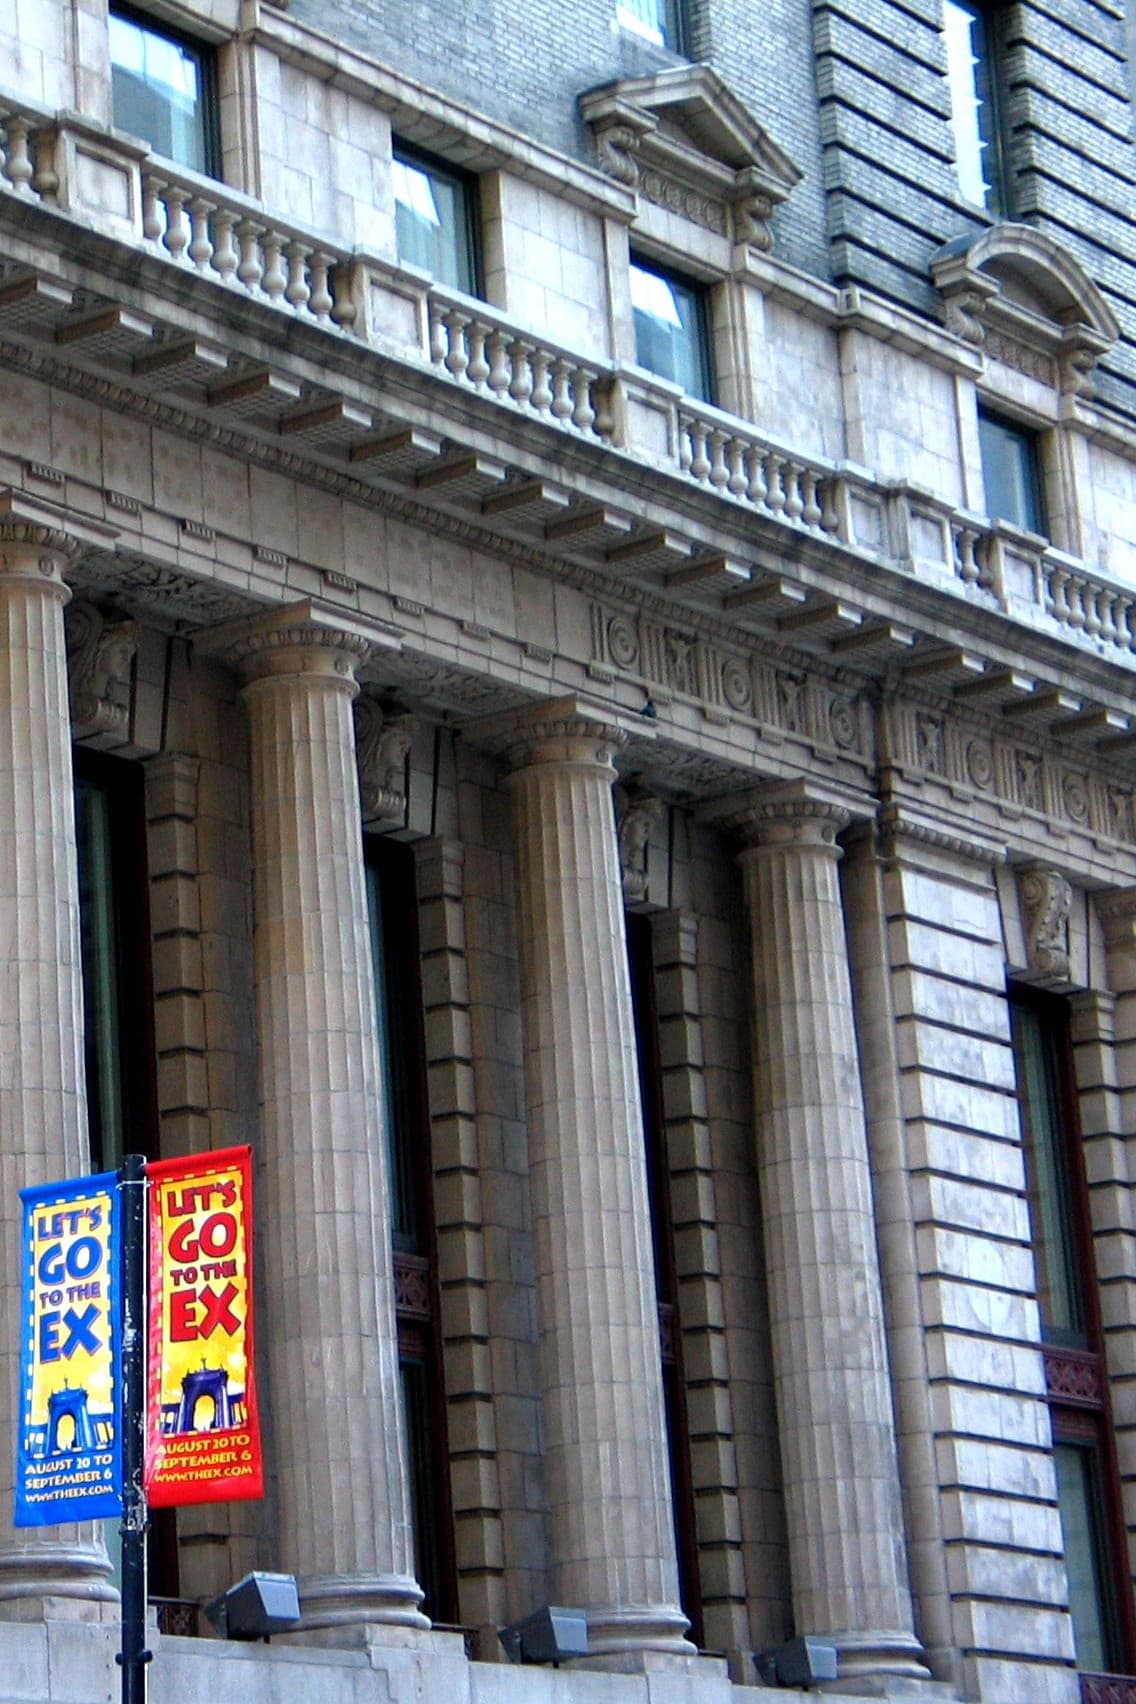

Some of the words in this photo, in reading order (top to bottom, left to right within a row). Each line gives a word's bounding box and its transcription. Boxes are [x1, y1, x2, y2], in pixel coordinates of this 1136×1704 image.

[167, 1180, 237, 1217] LET'S
[37, 1205, 102, 1241] LET'S
[168, 1211, 238, 1263] GO
[38, 1235, 103, 1286] GO
[170, 1266, 198, 1286] TO
[200, 1259, 237, 1281] THE
[39, 1289, 64, 1309] TO
[66, 1281, 101, 1303] THE
[170, 1281, 241, 1342] EX
[39, 1303, 103, 1364] EX
[154, 1451, 238, 1469] SEPTEMBER
[240, 1449, 252, 1461] 6
[155, 1440, 211, 1454] AUGUST
[212, 1438, 229, 1449] 20
[229, 1434, 251, 1446] TO
[25, 1458, 73, 1475] AUGUST
[76, 1457, 91, 1470] 20
[93, 1454, 113, 1466] TO
[25, 1470, 101, 1490] SEPTEMBER
[103, 1467, 113, 1480] 6
